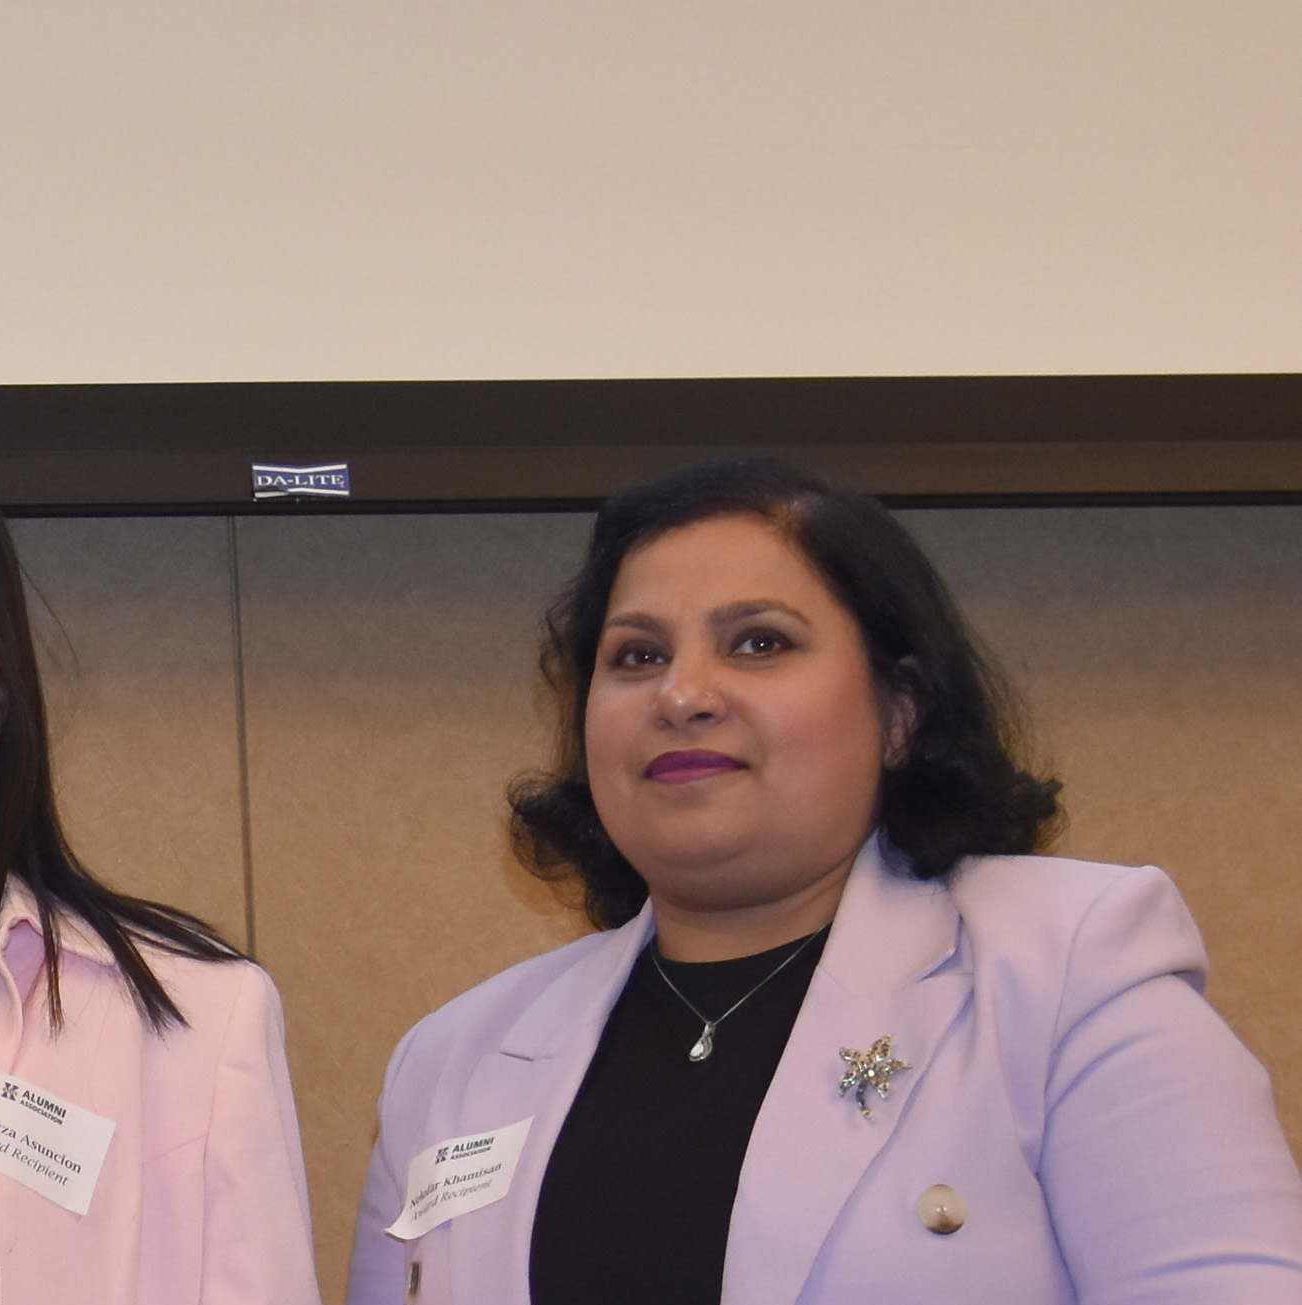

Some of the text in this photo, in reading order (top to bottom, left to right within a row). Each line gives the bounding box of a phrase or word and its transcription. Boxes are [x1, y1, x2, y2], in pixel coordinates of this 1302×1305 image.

[256, 474, 345, 487] DA-LITE
[19, 1099, 64, 1126] ASSOCIATION
[22, 1089, 67, 1119] ALUMNI
[19, 1134, 83, 1174] Asuncion
[452, 1136, 495, 1153] ALUMNI
[11, 1147, 69, 1187] Recipient
